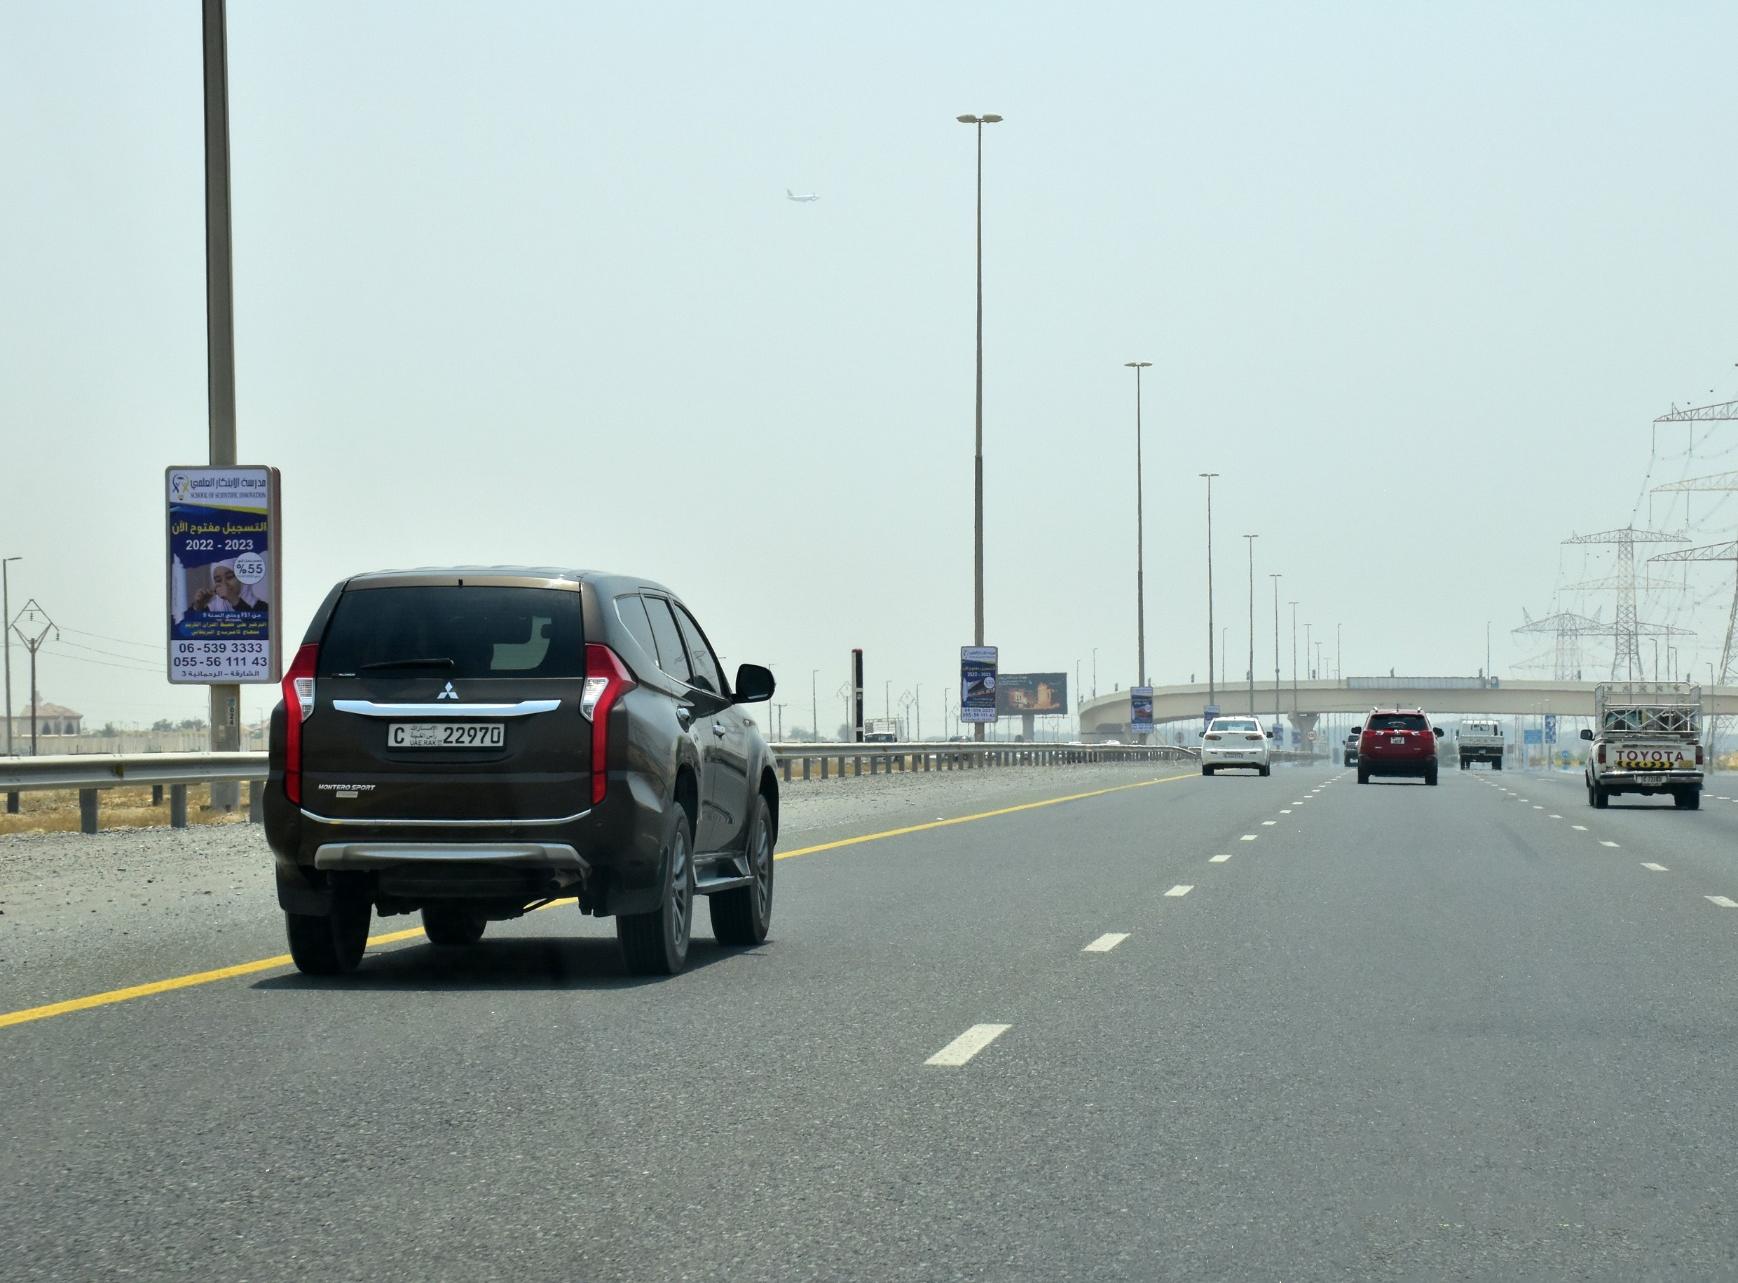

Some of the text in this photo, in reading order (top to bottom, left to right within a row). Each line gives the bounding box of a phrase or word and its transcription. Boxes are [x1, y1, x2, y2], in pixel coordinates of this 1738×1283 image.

[190, 477, 215, 489] العلمي
[240, 477, 266, 489] مدرسة
[190, 521, 220, 534] مفتوح
[222, 521, 268, 534] التسجيل
[185, 539, 214, 551] 2022
[224, 539, 254, 551] 2023
[231, 643, 263, 653] 3333
[225, 657, 247, 667] 111
[251, 657, 268, 667] 43
[230, 670, 260, 678] الشارقة
[393, 726, 501, 744] C 22970
[1616, 750, 1684, 762] TOYOTA
